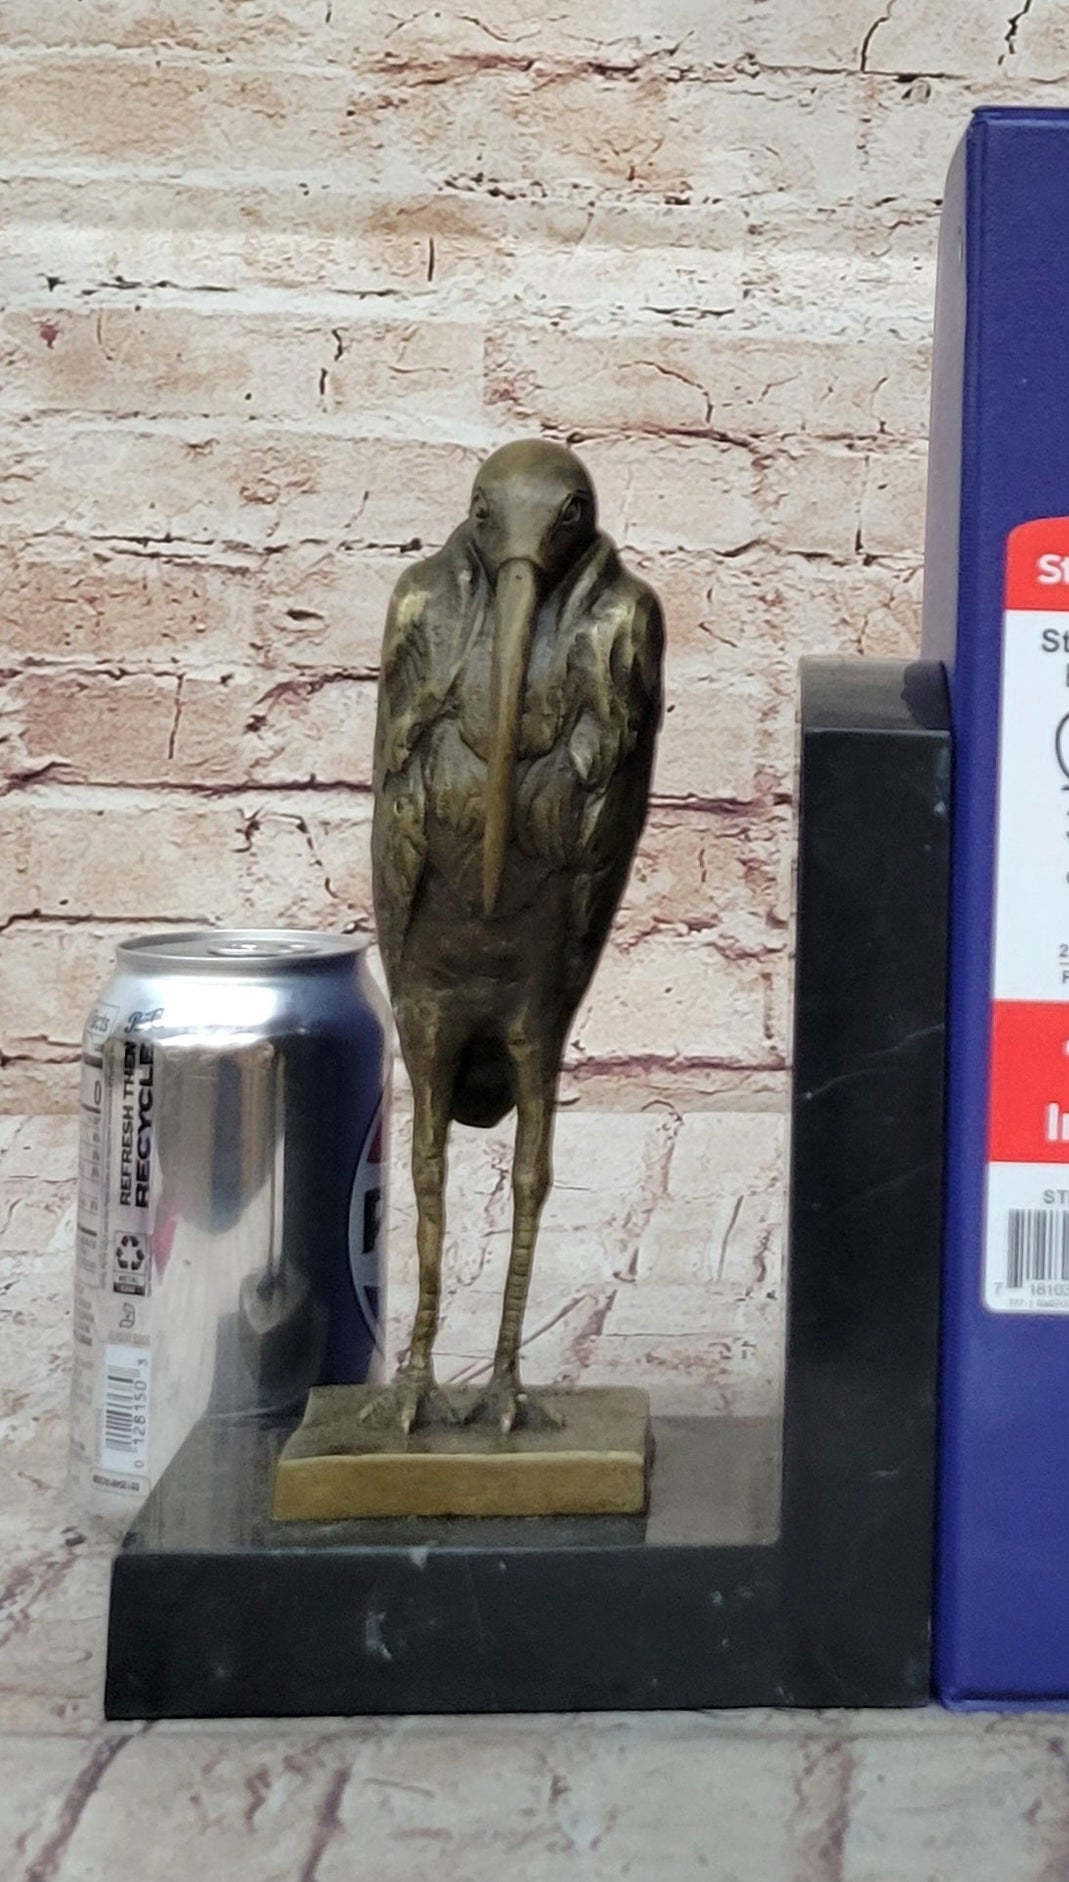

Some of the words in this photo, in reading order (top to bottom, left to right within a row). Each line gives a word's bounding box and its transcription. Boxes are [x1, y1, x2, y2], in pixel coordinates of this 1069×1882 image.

[1059, 943, 1069, 958] 2
[120, 1105, 134, 1206] REFRESH
[135, 1043, 154, 1208] RECYCLE
